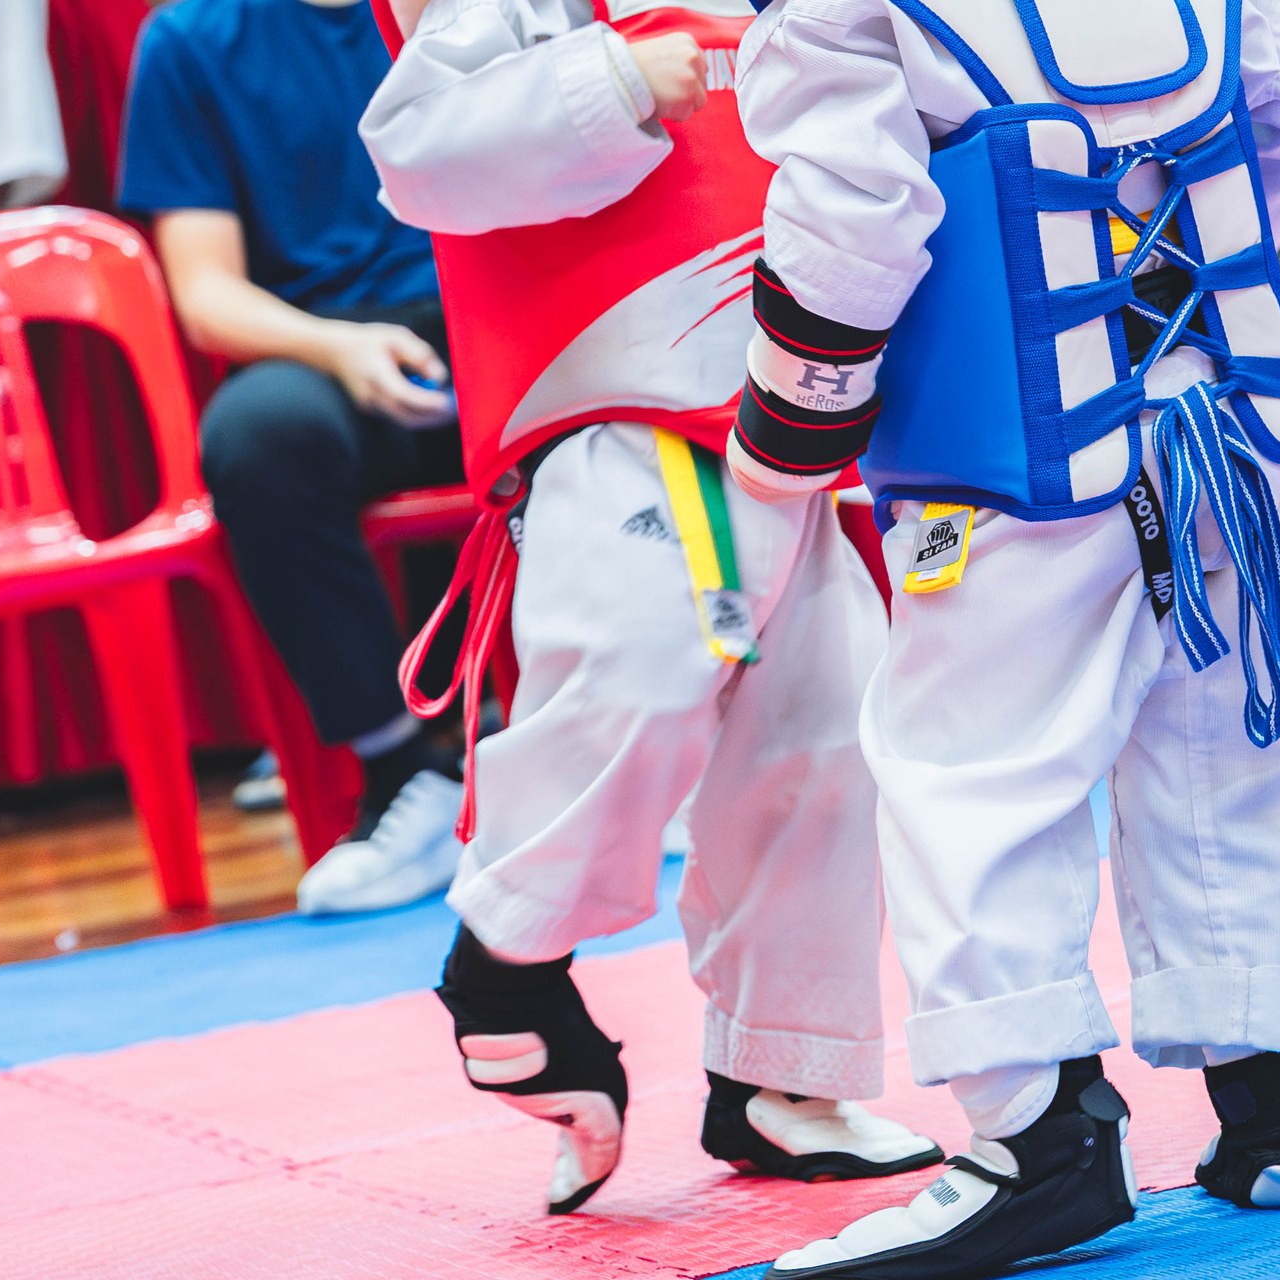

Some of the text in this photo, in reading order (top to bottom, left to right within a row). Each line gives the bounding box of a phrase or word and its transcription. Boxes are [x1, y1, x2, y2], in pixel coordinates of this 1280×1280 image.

[796, 363, 855, 395] H
[795, 394, 845, 411] HEROS
[1129, 476, 1160, 541] OOTO
[922, 539, 955, 559] SI FAN
